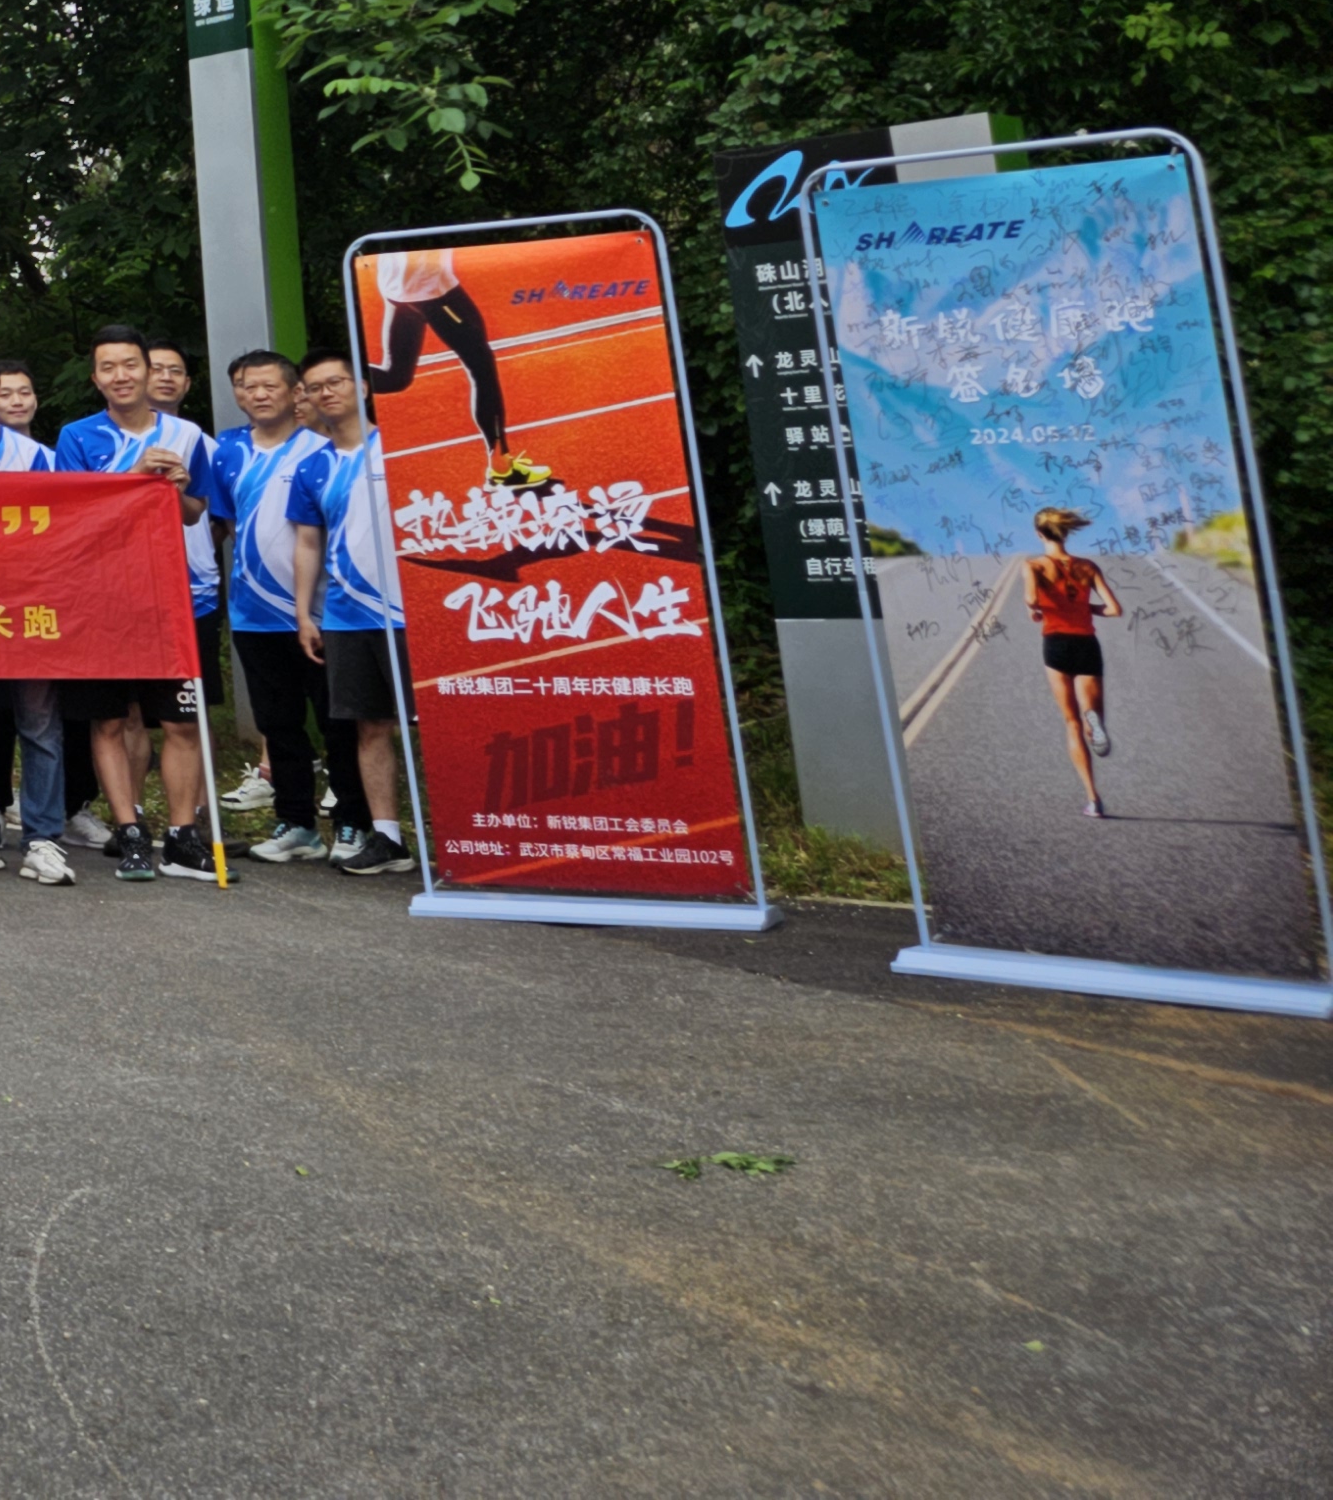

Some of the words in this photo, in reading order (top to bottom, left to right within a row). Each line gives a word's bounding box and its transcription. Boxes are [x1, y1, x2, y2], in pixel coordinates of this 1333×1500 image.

[881, 297, 1154, 350] 新锐健康跑
[946, 356, 1105, 403] 签名墙
[394, 480, 660, 555] 热辣滚烫
[443, 576, 702, 643] 飞驰人生
[437, 676, 694, 697] 新锐集团二十周年庆健康长跑
